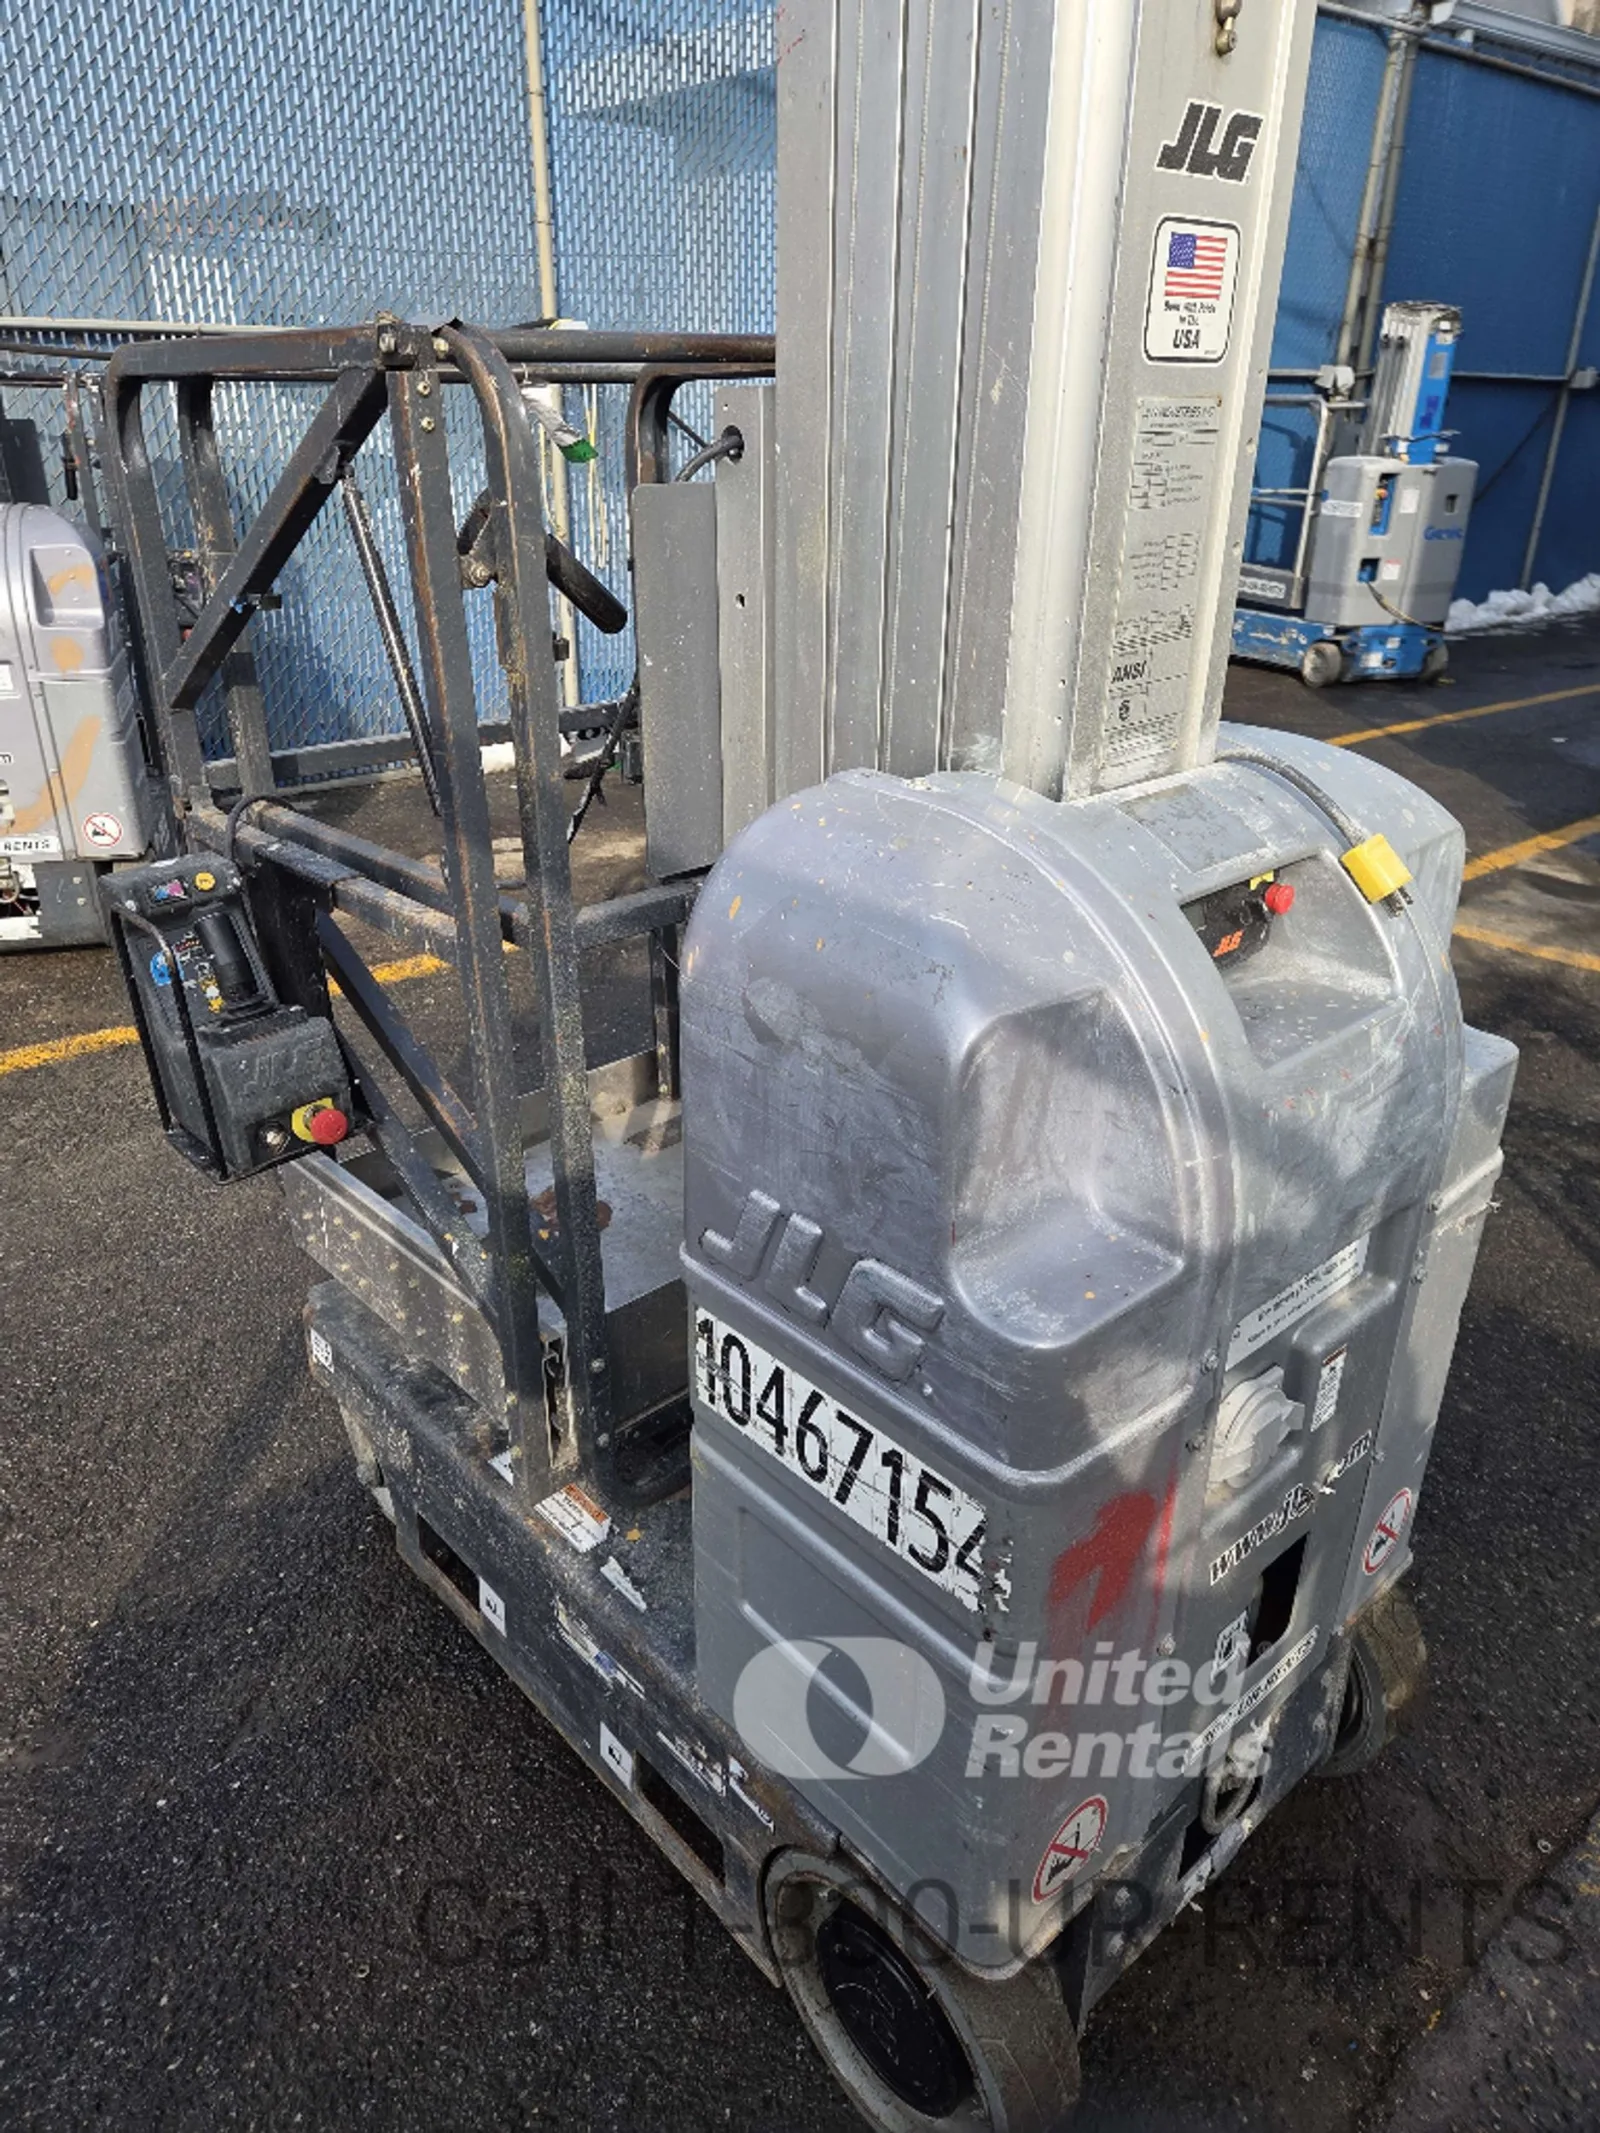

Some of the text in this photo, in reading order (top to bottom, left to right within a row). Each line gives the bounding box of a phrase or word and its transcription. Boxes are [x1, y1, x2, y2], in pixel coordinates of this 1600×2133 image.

[1157, 102, 1263, 182] JLG
[1172, 329, 1201, 349] USA
[1112, 661, 1147, 684] ANSI
[699, 1188, 944, 1384] JLG
